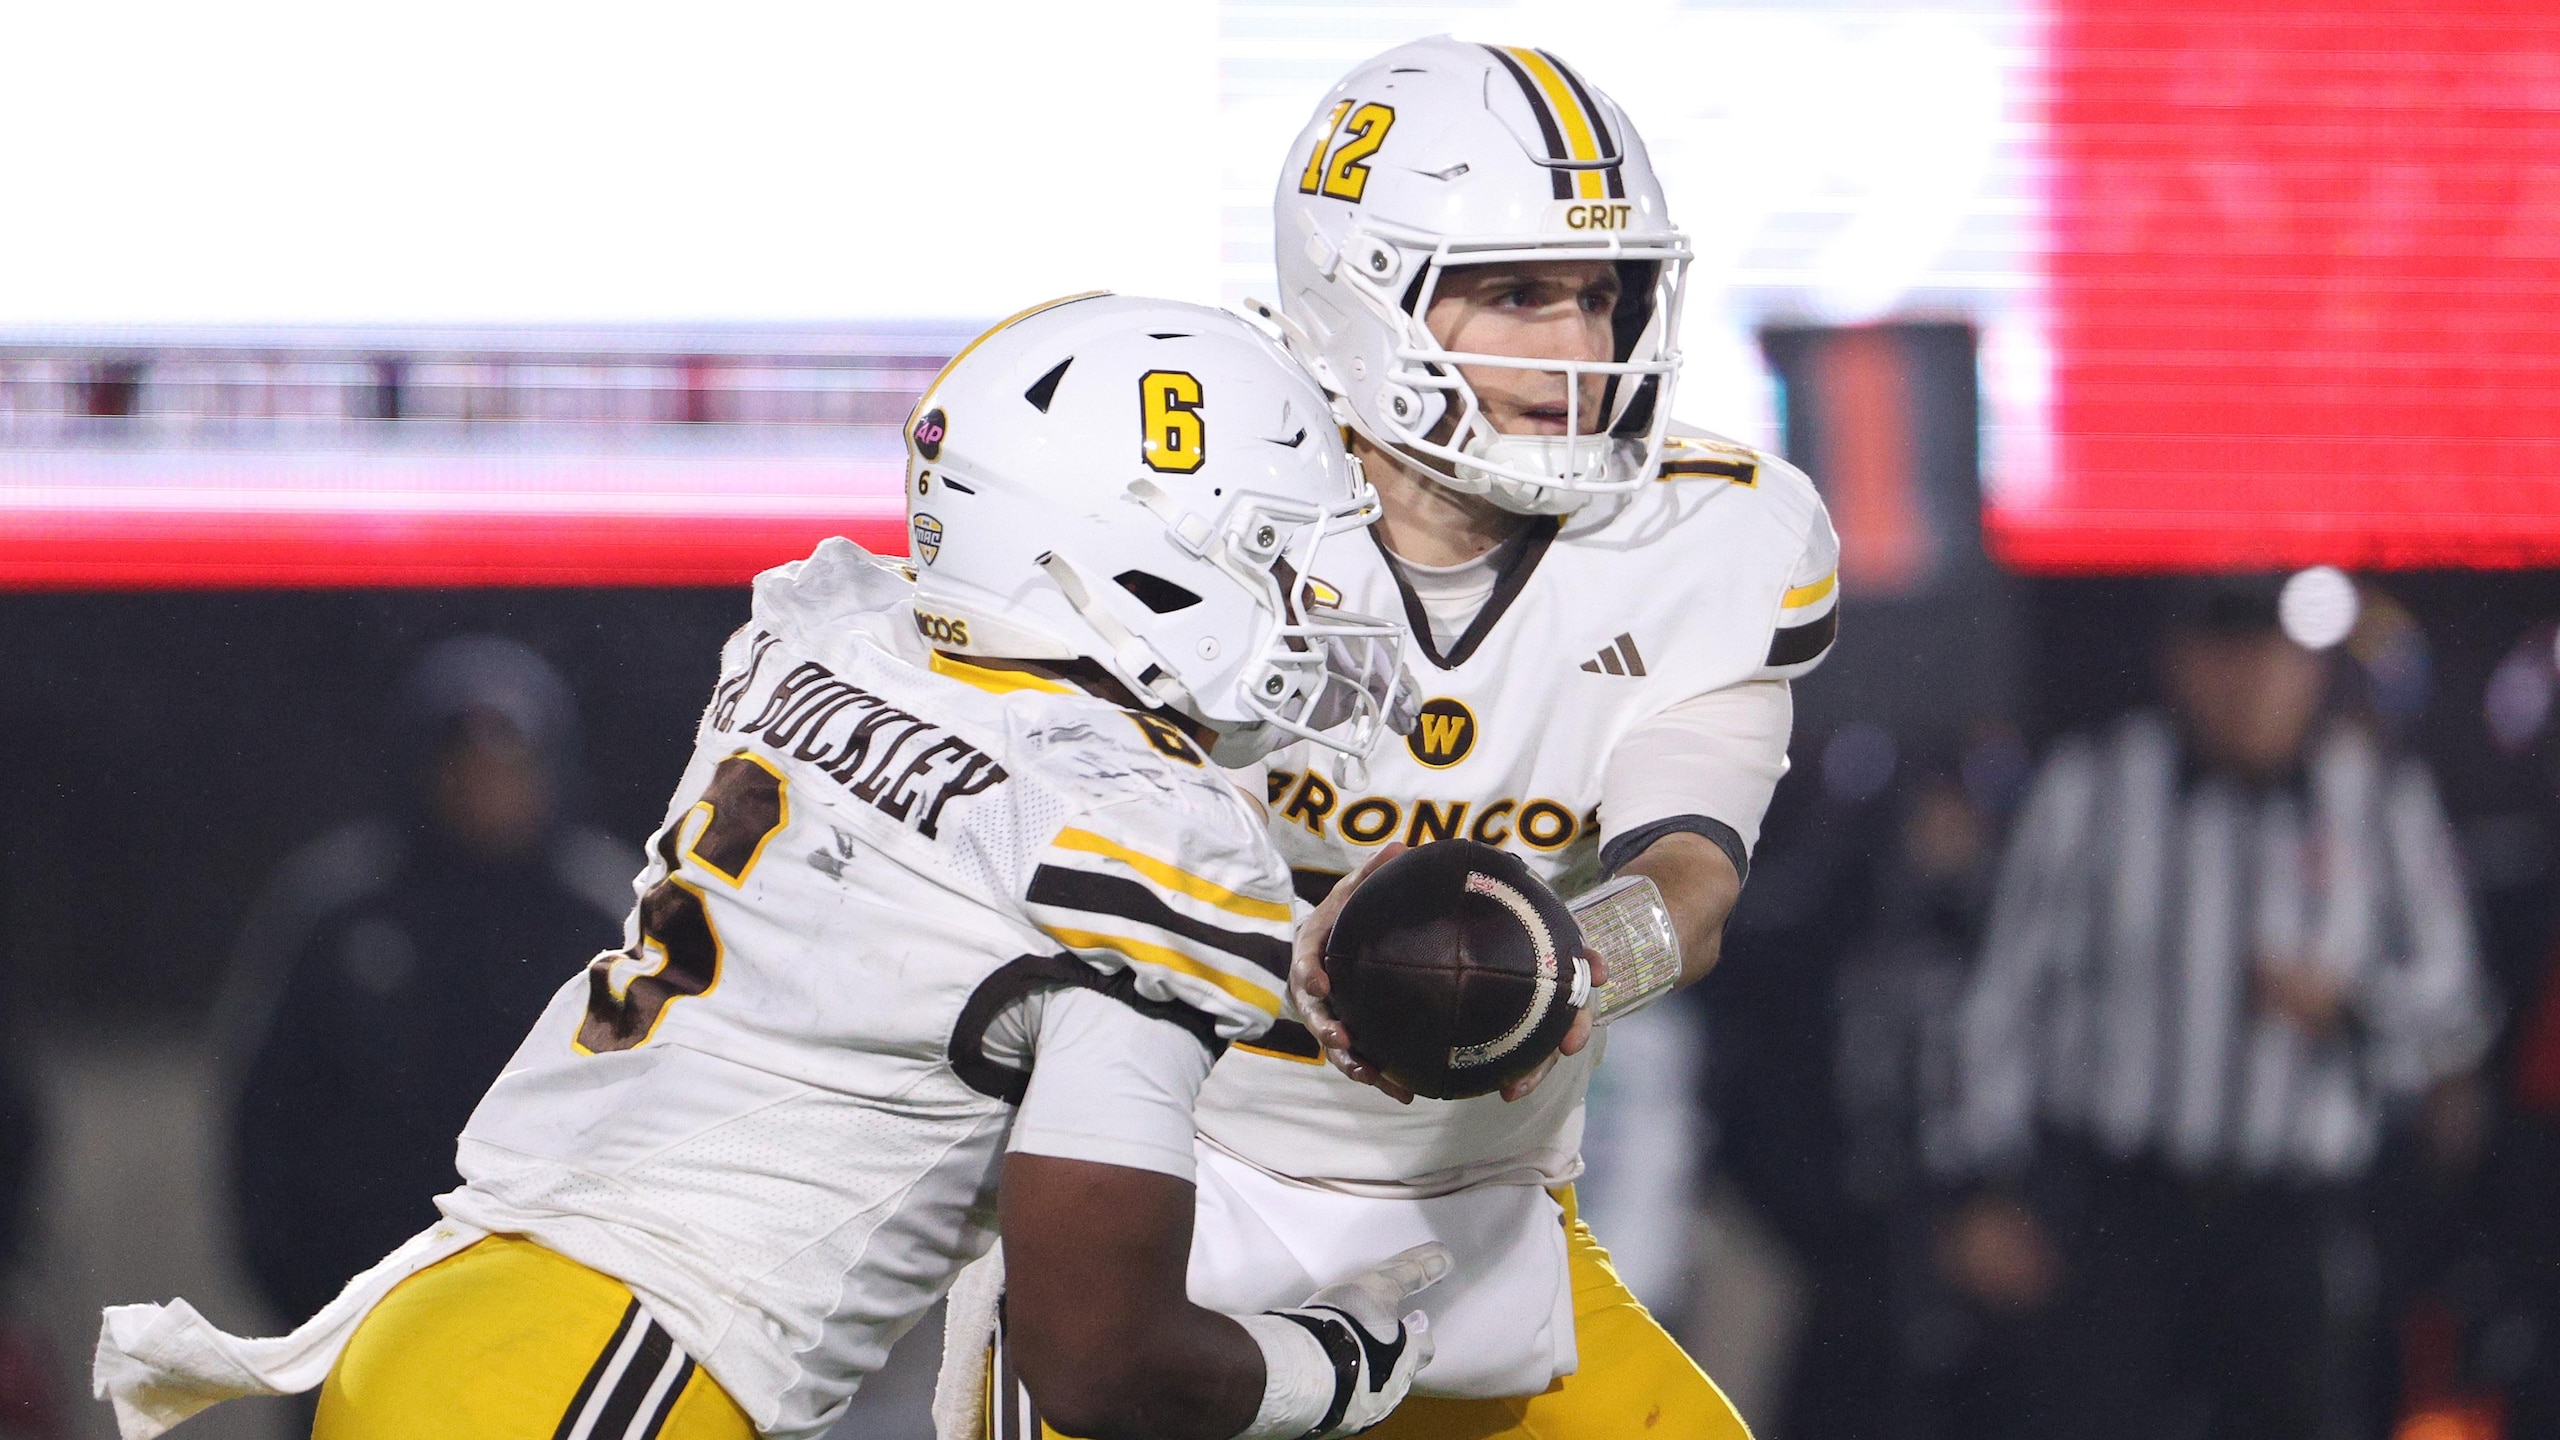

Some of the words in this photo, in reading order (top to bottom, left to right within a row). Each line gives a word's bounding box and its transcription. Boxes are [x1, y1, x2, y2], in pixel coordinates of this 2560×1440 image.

[1299, 98, 1396, 204] 12
[1566, 204, 1632, 231] GRIT
[914, 422, 944, 445] AP
[1138, 369, 1206, 474] 6
[918, 470, 931, 495] 6
[915, 528, 941, 547] MAC
[1420, 712, 1466, 755] W
[571, 750, 790, 1058] 6
